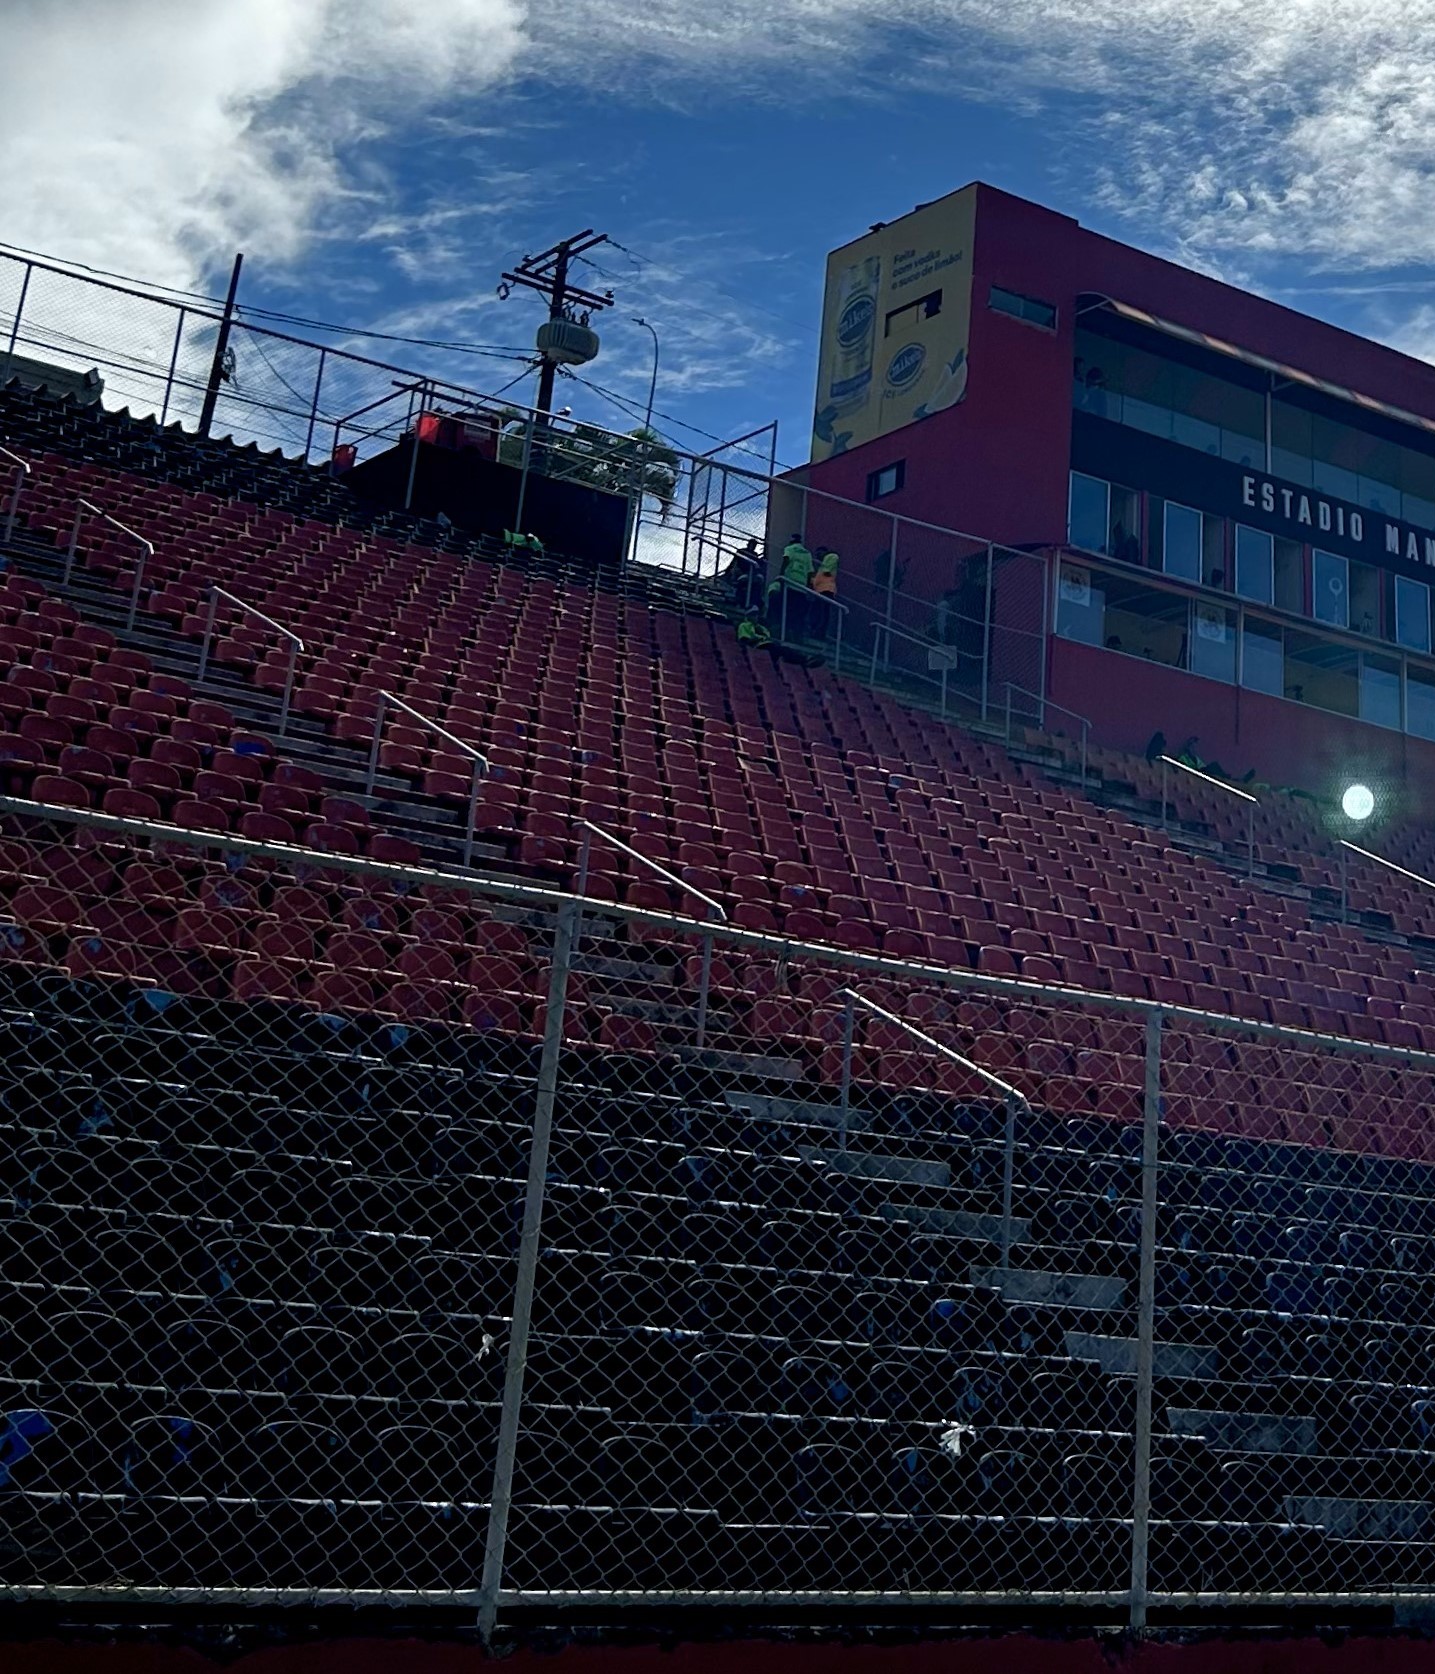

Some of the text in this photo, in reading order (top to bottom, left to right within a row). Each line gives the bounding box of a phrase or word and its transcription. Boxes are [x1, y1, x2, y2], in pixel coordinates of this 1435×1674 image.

[894, 249, 915, 264] Feita
[893, 263, 913, 277] com
[898, 271, 921, 287] suco
[921, 265, 933, 277] de
[1243, 476, 1363, 541] ESTADIO
